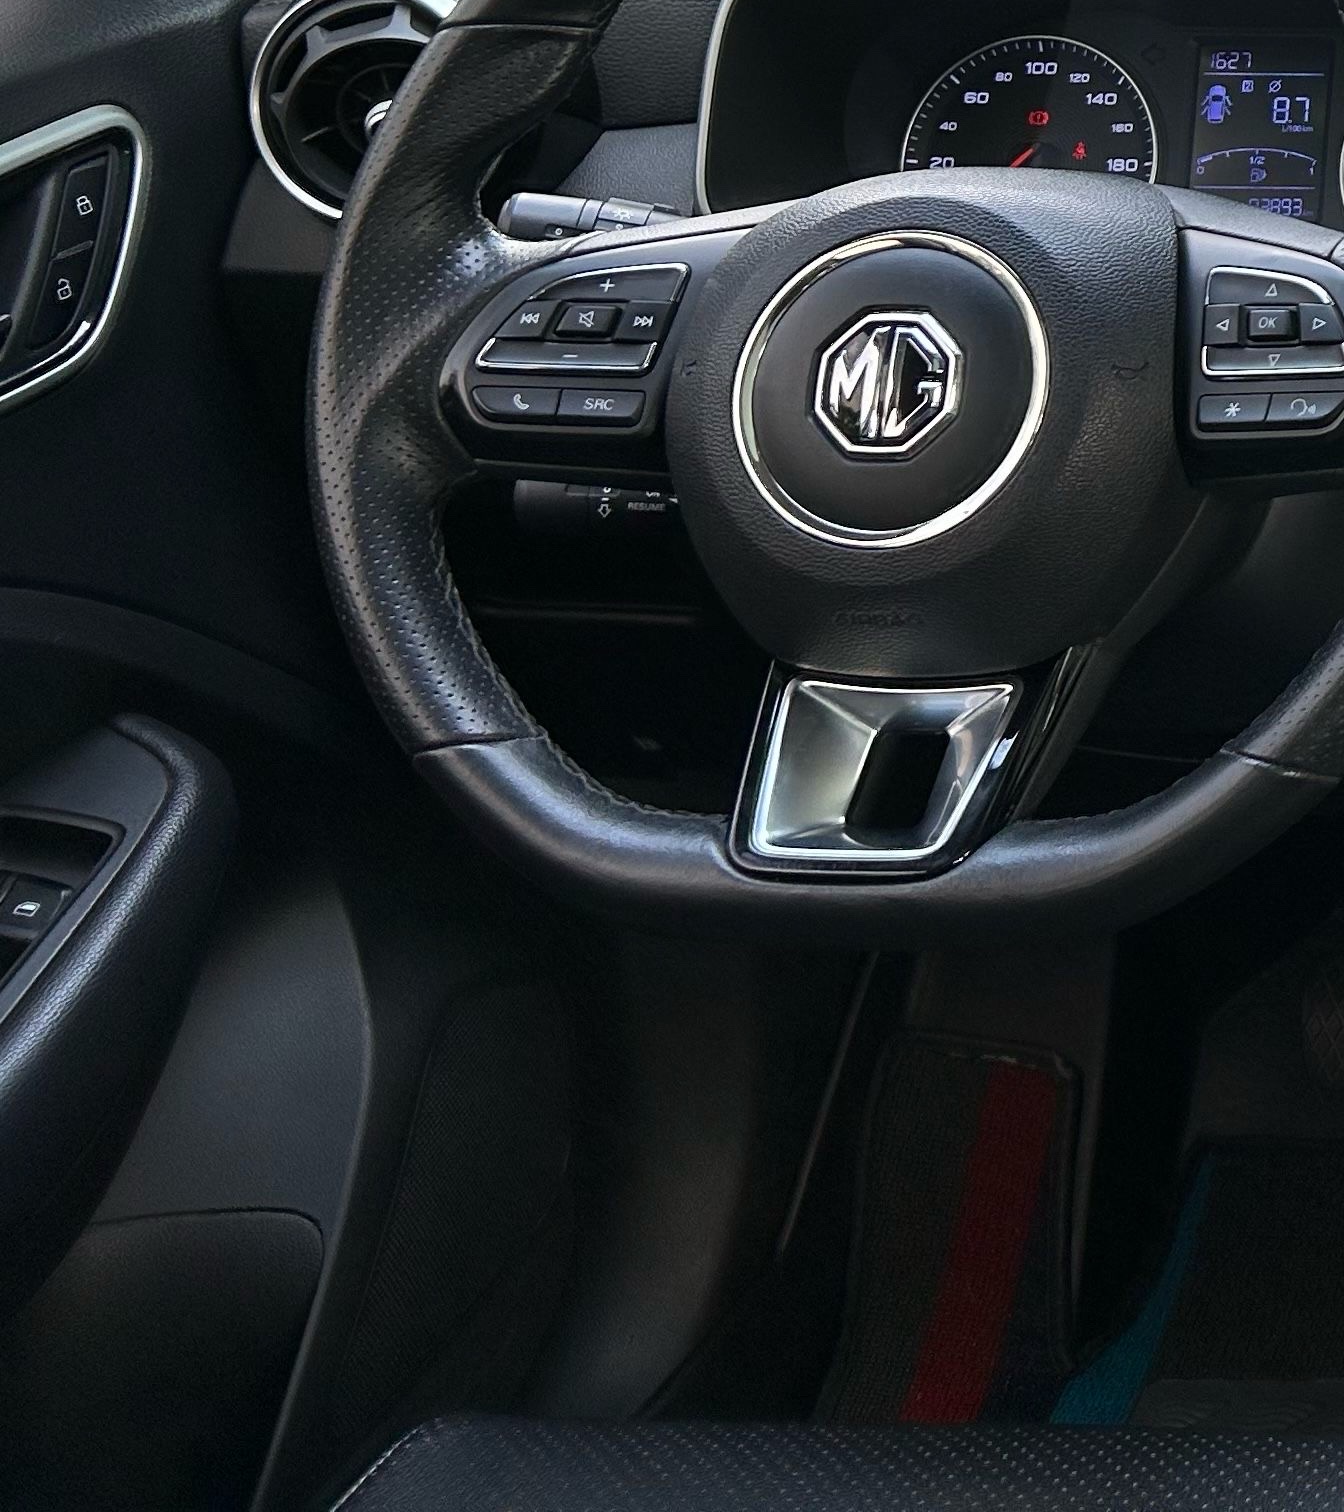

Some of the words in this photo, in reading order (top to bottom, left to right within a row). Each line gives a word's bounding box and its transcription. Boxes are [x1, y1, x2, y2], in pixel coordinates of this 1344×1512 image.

[1024, 61, 1058, 75] 100
[995, 72, 1013, 82] 80
[1069, 73, 1091, 83] 120
[963, 91, 990, 104] 60
[1085, 92, 1118, 105] 140
[1272, 96, 1310, 124] 8.7
[939, 121, 958, 131] 40
[1111, 123, 1134, 133] 160
[929, 156, 955, 169] 20
[1106, 158, 1139, 172] 180
[1258, 316, 1278, 329] OK
[829, 324, 947, 439] MG
[583, 398, 615, 411] SRC
[627, 502, 666, 511] RESUME
